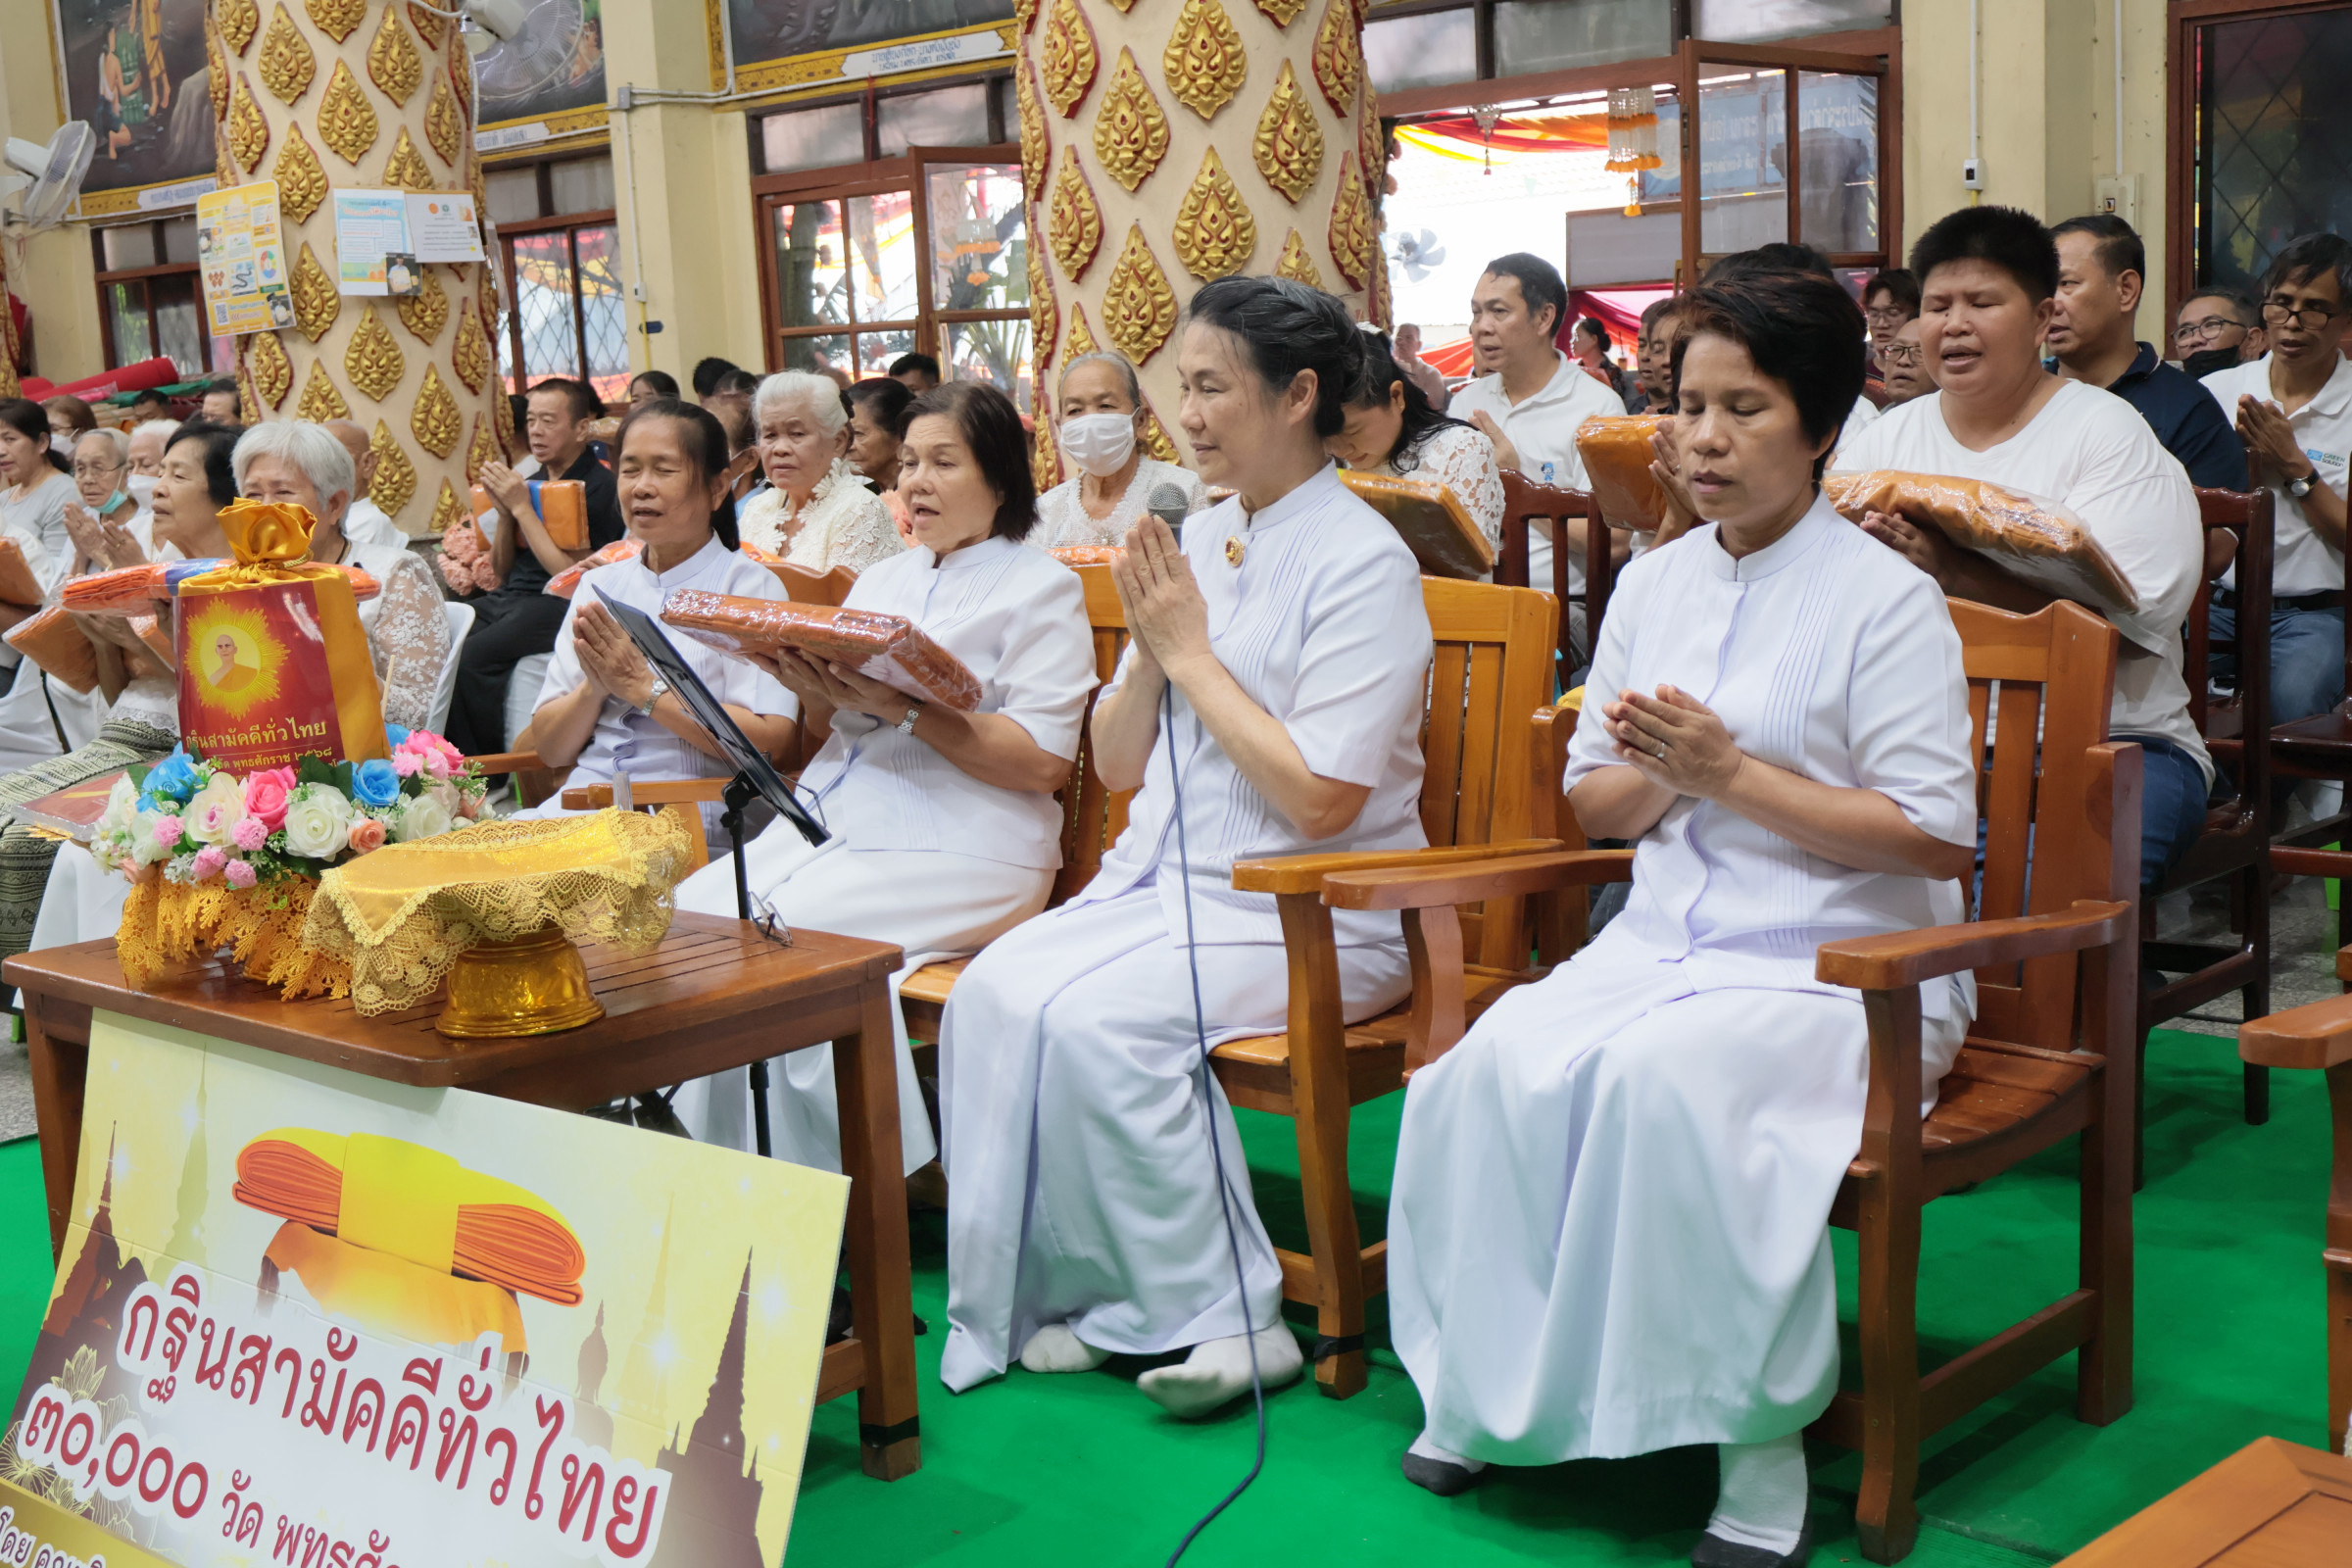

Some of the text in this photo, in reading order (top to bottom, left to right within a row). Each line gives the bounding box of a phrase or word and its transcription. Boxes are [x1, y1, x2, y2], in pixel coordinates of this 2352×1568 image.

[2322, 458, 2344, 467] Solution
[2323, 453, 2345, 463] GREEN
[232, 752, 291, 772] พุทธศักราช
[123, 1274, 660, 1559] กฐินสามัคคีทั่วไทย
[24, 1396, 209, 1519] ๓๐,๐๐๐
[221, 1469, 265, 1549] วัด
